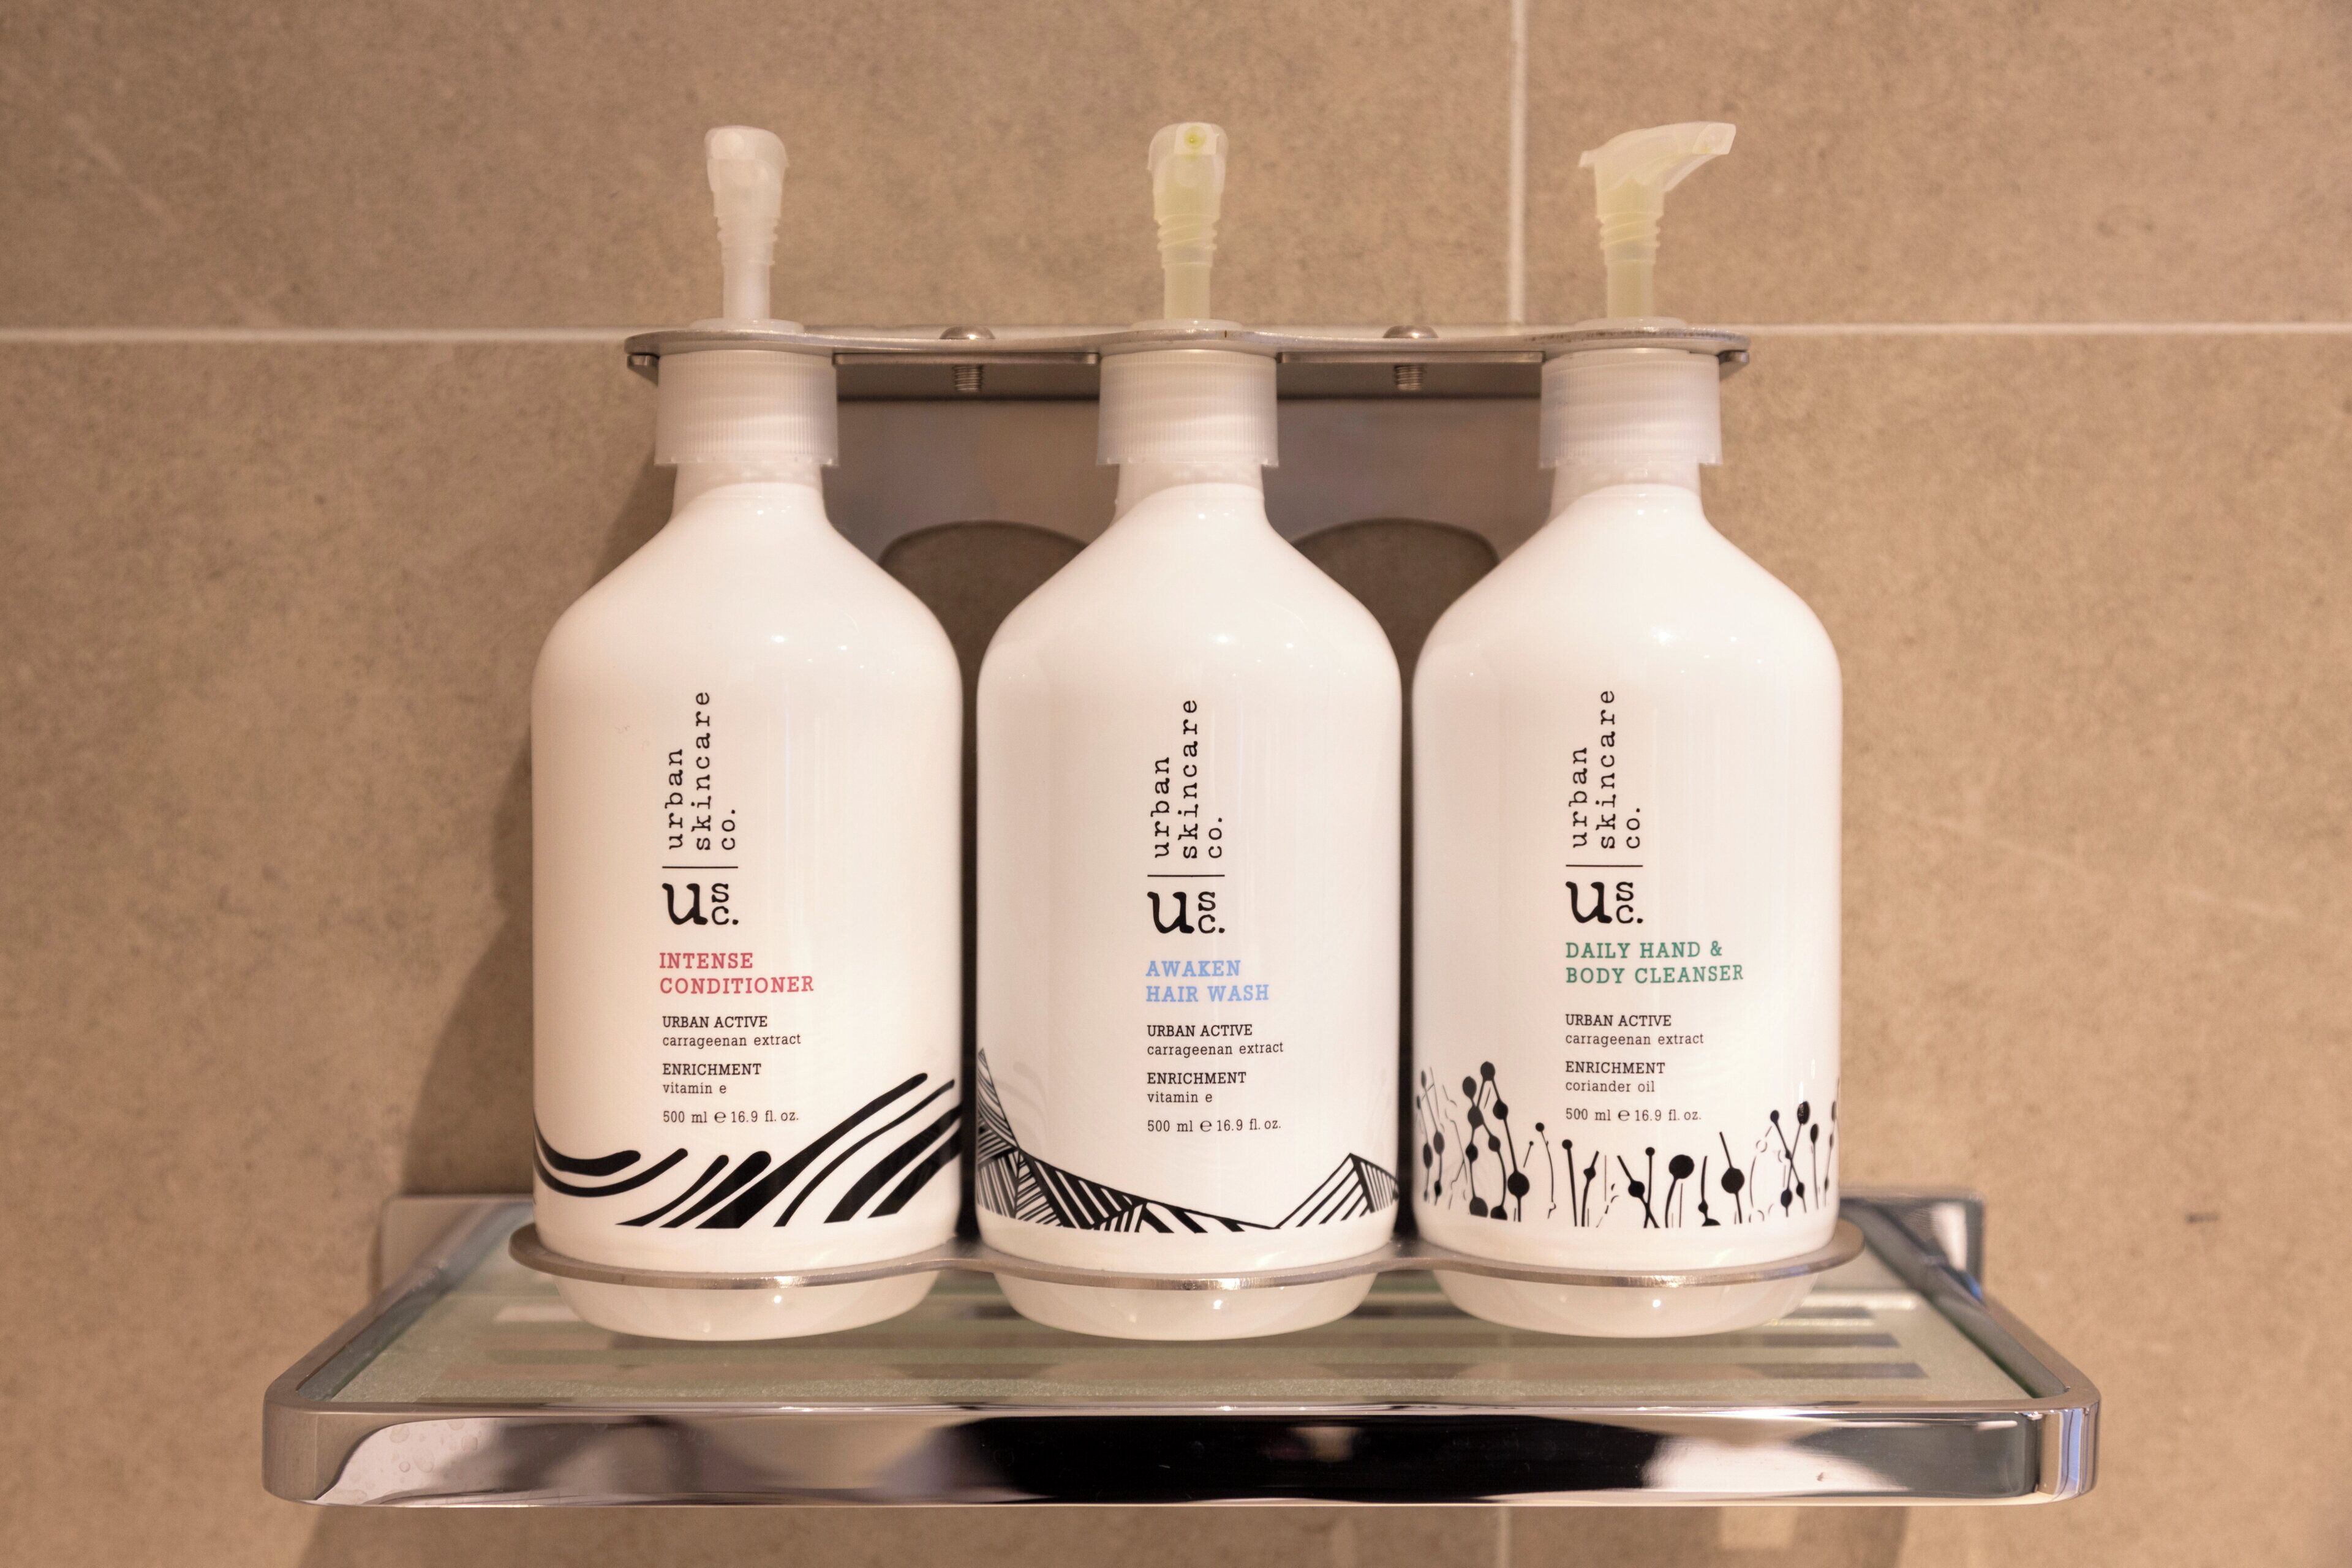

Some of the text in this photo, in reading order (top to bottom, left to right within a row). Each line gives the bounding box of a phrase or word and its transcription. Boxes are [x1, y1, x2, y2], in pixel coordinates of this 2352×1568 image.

[690, 692, 712, 850] skincare
[1594, 690, 1616, 849] skincare
[1177, 699, 1199, 859] skincare
[664, 748, 683, 850] urban
[1567, 747, 1588, 848] urban
[1150, 756, 1170, 858] urban
[720, 809, 736, 850] co.
[1626, 807, 1640, 849] co.
[1208, 817, 1223, 859] co.
[1565, 940, 1722, 959] DAILY HAND &
[659, 952, 753, 969] INTENSE
[1145, 960, 1240, 976] AWAKEN
[1566, 964, 1743, 984] BODY CLEANSER
[660, 975, 814, 994] CONDITIONER
[1146, 984, 1268, 1001] HAIR WASH
[662, 1015, 767, 1028] URBAN ACTIVE
[1565, 1013, 1672, 1027] URBAN ACTIVE
[1146, 1023, 1253, 1037] URBAN ACTIVE
[662, 1033, 801, 1049] carrageenan extract
[1565, 1033, 1704, 1047] carrageenan extract
[1147, 1041, 1283, 1058] carrageenan extract
[662, 1063, 761, 1076] ENRICHMENT
[1565, 1060, 1665, 1074] ENRICHMENT
[1146, 1071, 1246, 1084] ENRICHMENT
[662, 1081, 726, 1094] vitamin e
[1565, 1080, 1654, 1092] coriander oil
[1147, 1091, 1212, 1102] vitamin e
[663, 1110, 685, 1123] 500
[690, 1110, 707, 1123] ml
[730, 1110, 758, 1123] 16.9
[764, 1109, 776, 1122] fl.
[780, 1111, 799, 1121] oz.
[1566, 1107, 1588, 1120] 500
[1594, 1109, 1611, 1121] ml
[1635, 1109, 1661, 1121] 16.9
[1668, 1109, 1680, 1121] fl.
[1683, 1111, 1701, 1120] oz.
[1147, 1119, 1170, 1132] 500
[1176, 1120, 1193, 1132] ml
[1216, 1118, 1243, 1131] 16.9
[1249, 1118, 1260, 1130] fl.
[1264, 1120, 1281, 1129] oz.
